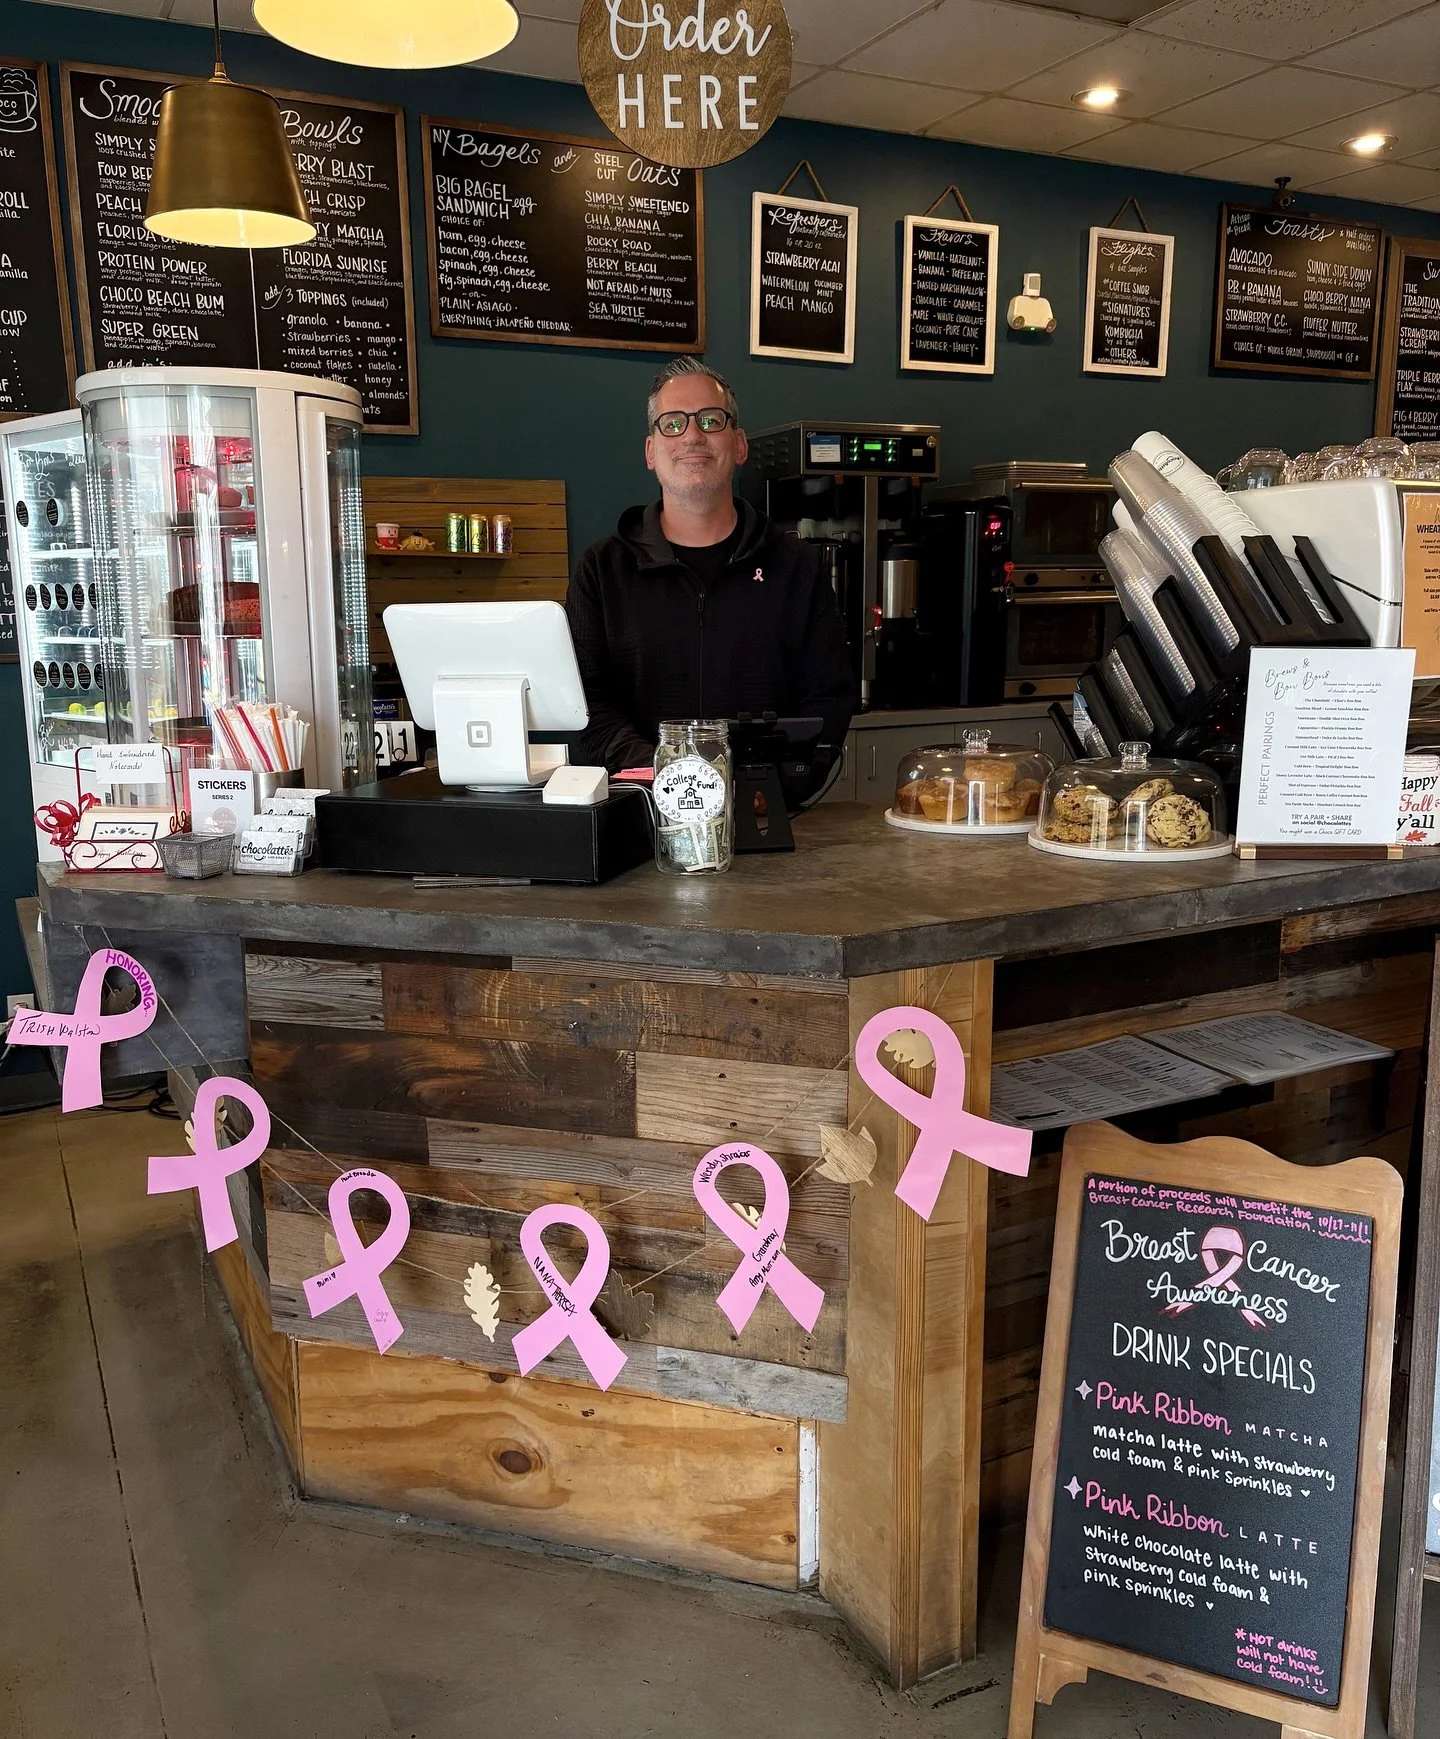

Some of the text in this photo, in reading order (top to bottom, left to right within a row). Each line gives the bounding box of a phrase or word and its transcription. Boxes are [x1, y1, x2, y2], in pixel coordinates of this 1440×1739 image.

[605, 0, 772, 60] Order
[618, 74, 758, 129] HERE
[280, 110, 364, 145] Bowls
[95, 132, 143, 150] SIMPLY
[309, 140, 337, 152] toppings
[456, 133, 541, 167] Bagels
[98, 162, 127, 178] FOUR
[331, 159, 374, 181] BLAST
[594, 153, 624, 168] STEEL
[597, 168, 617, 181] CUT
[627, 158, 681, 187] Oats
[436, 174, 512, 202] BIG BAGEL
[96, 193, 142, 212] PEACH
[327, 193, 366, 211] CRISP
[437, 196, 509, 220] SANDWICH
[585, 190, 625, 206] SIMPLY
[628, 196, 689, 214] SWEETENED
[441, 215, 470, 226] CHOICE
[585, 213, 611, 226] CHIA
[615, 216, 660, 232] BANANA
[768, 207, 843, 234] Refreshers
[1264, 219, 1335, 242] Toasts
[337, 224, 384, 241] MATCHA
[920, 228, 978, 246] Flavors
[587, 235, 652, 251] ROCKY ROAD
[1101, 241, 1155, 264] Flights
[98, 251, 208, 275] PROTEIN POWER
[282, 248, 387, 273] FLORIDA SUNRISE
[587, 256, 657, 274] BERRY BEACH
[765, 251, 840, 273] STRAWBERRY ACAI
[918, 250, 945, 262] VANILLA
[1229, 247, 1272, 267] AVOCADO
[1307, 259, 1372, 282] SUNNY SIDE DOWN
[587, 278, 672, 298] NOT AFRAID NUTS
[762, 274, 843, 292] WATERMELON CUCUMBER
[1109, 280, 1130, 293] COFFEE
[100, 285, 224, 310] CHOCO BEACH BUM
[296, 289, 389, 309] TOPPINGS (included)
[766, 294, 834, 314] PEACH MANGO
[1304, 290, 1323, 303] CHOCO
[1326, 292, 1348, 306] BERRY
[1350, 296, 1371, 309] NANA
[1, 310, 27, 326] CUP
[588, 302, 645, 318] SEA TURTLE
[1107, 302, 1150, 318] SIGNATURES
[1226, 309, 1271, 328] STRAWBERRY
[101, 318, 199, 340] SUPER GREEN
[287, 313, 382, 330] granola banana
[442, 313, 571, 332] EVERYTHING CHEDDAR
[367, 335, 396, 347] mango
[1105, 325, 1143, 340] KOMBUCHA
[288, 346, 354, 357] mixed berries
[915, 339, 975, 357] LAVENDER HONEY
[1110, 348, 1137, 359] OTHERS
[1234, 341, 1254, 352] CHOICE
[364, 372, 391, 388] honey
[369, 389, 405, 400] almonds
[1265, 665, 1299, 688] Brews
[1258, 711, 1275, 805] PERFECT PAIRINGS
[198, 780, 247, 790] STICKERS
[1399, 794, 1433, 813] Fall
[699, 1159, 723, 1183] Wendy
[1088, 1178, 1313, 1219] A portion of proceeds will benefit the
[1088, 1192, 1129, 1206] Breast
[1176, 1201, 1235, 1219] Research
[1238, 1210, 1316, 1233] Foundation.
[1100, 1219, 1341, 1303] Breast Cancer
[534, 1256, 554, 1289] NANA
[1147, 1270, 1288, 1323] Awareness
[1113, 1322, 1316, 1395] DRINK SPECIALS
[1096, 1381, 1328, 1448] Pink Ribbon MATCHA
[1093, 1425, 1336, 1492] matcha latte with strawberry
[1093, 1445, 1292, 1498] cold foam & pink sprinkles
[1085, 1480, 1318, 1555] Pink Ribbon LATTE
[1083, 1525, 1308, 1589] white chocolate latte with
[1085, 1547, 1271, 1605] strawberry cold foam &
[1084, 1568, 1195, 1608] pink sprinkles
[1277, 1638, 1318, 1661] drinks
[1236, 1658, 1263, 1674] cold
[1237, 1645, 1324, 1675] will not have
